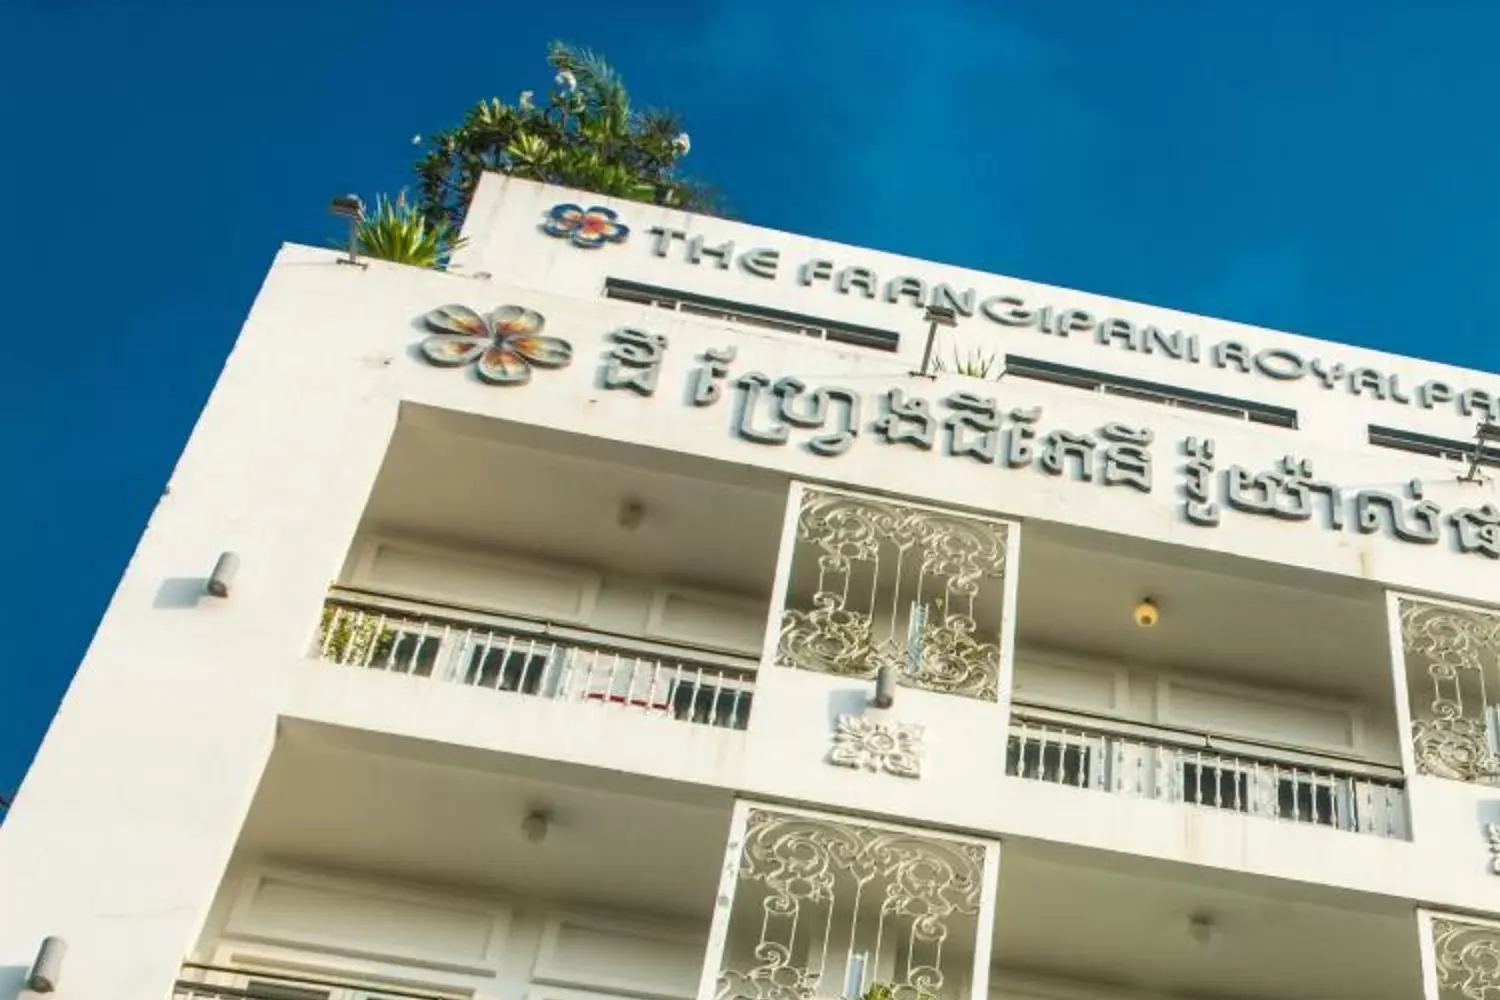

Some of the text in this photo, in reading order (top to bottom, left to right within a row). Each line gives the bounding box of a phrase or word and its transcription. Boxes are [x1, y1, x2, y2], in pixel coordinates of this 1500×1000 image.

[648, 226, 780, 280] THE
[797, 257, 1200, 364] FRANGIPANI
[1212, 340, 1410, 405] ROYAL
